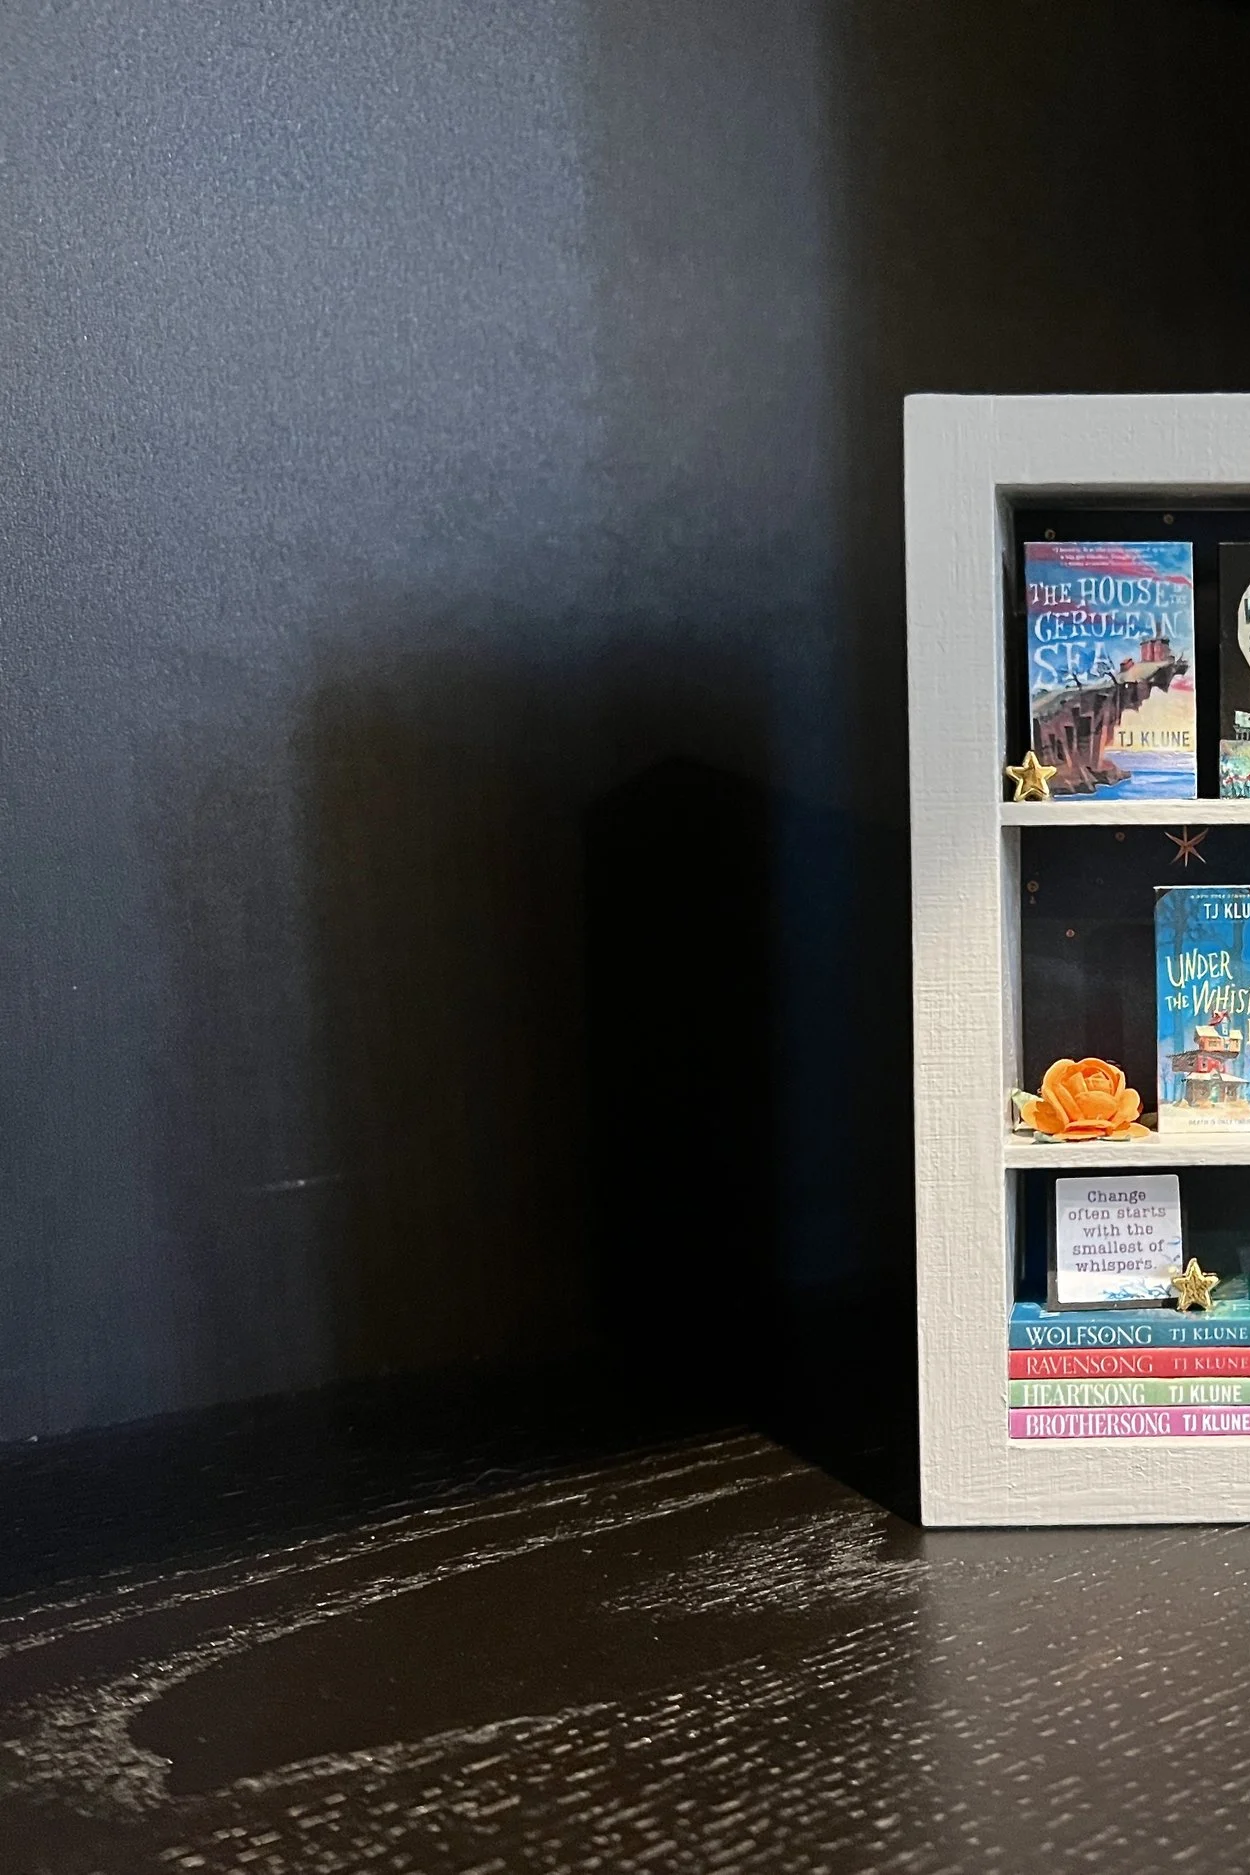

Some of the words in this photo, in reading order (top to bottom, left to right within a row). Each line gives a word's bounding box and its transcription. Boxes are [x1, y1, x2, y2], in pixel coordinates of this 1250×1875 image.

[1030, 582, 1071, 606] THE
[1077, 575, 1170, 608] HOUSE
[1034, 609, 1183, 642] CERULEAN
[1034, 641, 1116, 691] SEA
[1119, 731, 1134, 748] TJ
[1141, 731, 1190, 748] KLUNE
[1203, 903, 1219, 919] TJ
[1166, 948, 1233, 988] UNDER
[1165, 993, 1189, 1012] THE
[1087, 1190, 1146, 1204] Change
[1068, 1208, 1110, 1221] often
[1117, 1206, 1166, 1219] starts
[1083, 1224, 1120, 1238] with
[1127, 1223, 1154, 1236] the
[1072, 1240, 1143, 1256] smallest
[1149, 1239, 1166, 1253] of
[1075, 1259, 1158, 1274] whispers.
[1026, 1325, 1152, 1346] WOLFSONG
[1169, 1328, 1186, 1342] TJ
[1193, 1327, 1248, 1340] KLUNE
[1026, 1355, 1153, 1375] RAVENSONG
[1173, 1357, 1187, 1370] TJ
[1194, 1356, 1249, 1370] KLUNE
[1023, 1383, 1145, 1407] HEARTSONG
[1169, 1385, 1184, 1402] TJ
[1190, 1385, 1242, 1404] KLUNE
[1026, 1411, 1171, 1436] BROTHERSONG
[1182, 1413, 1197, 1431] TJ
[1201, 1413, 1250, 1431] KLUNE
